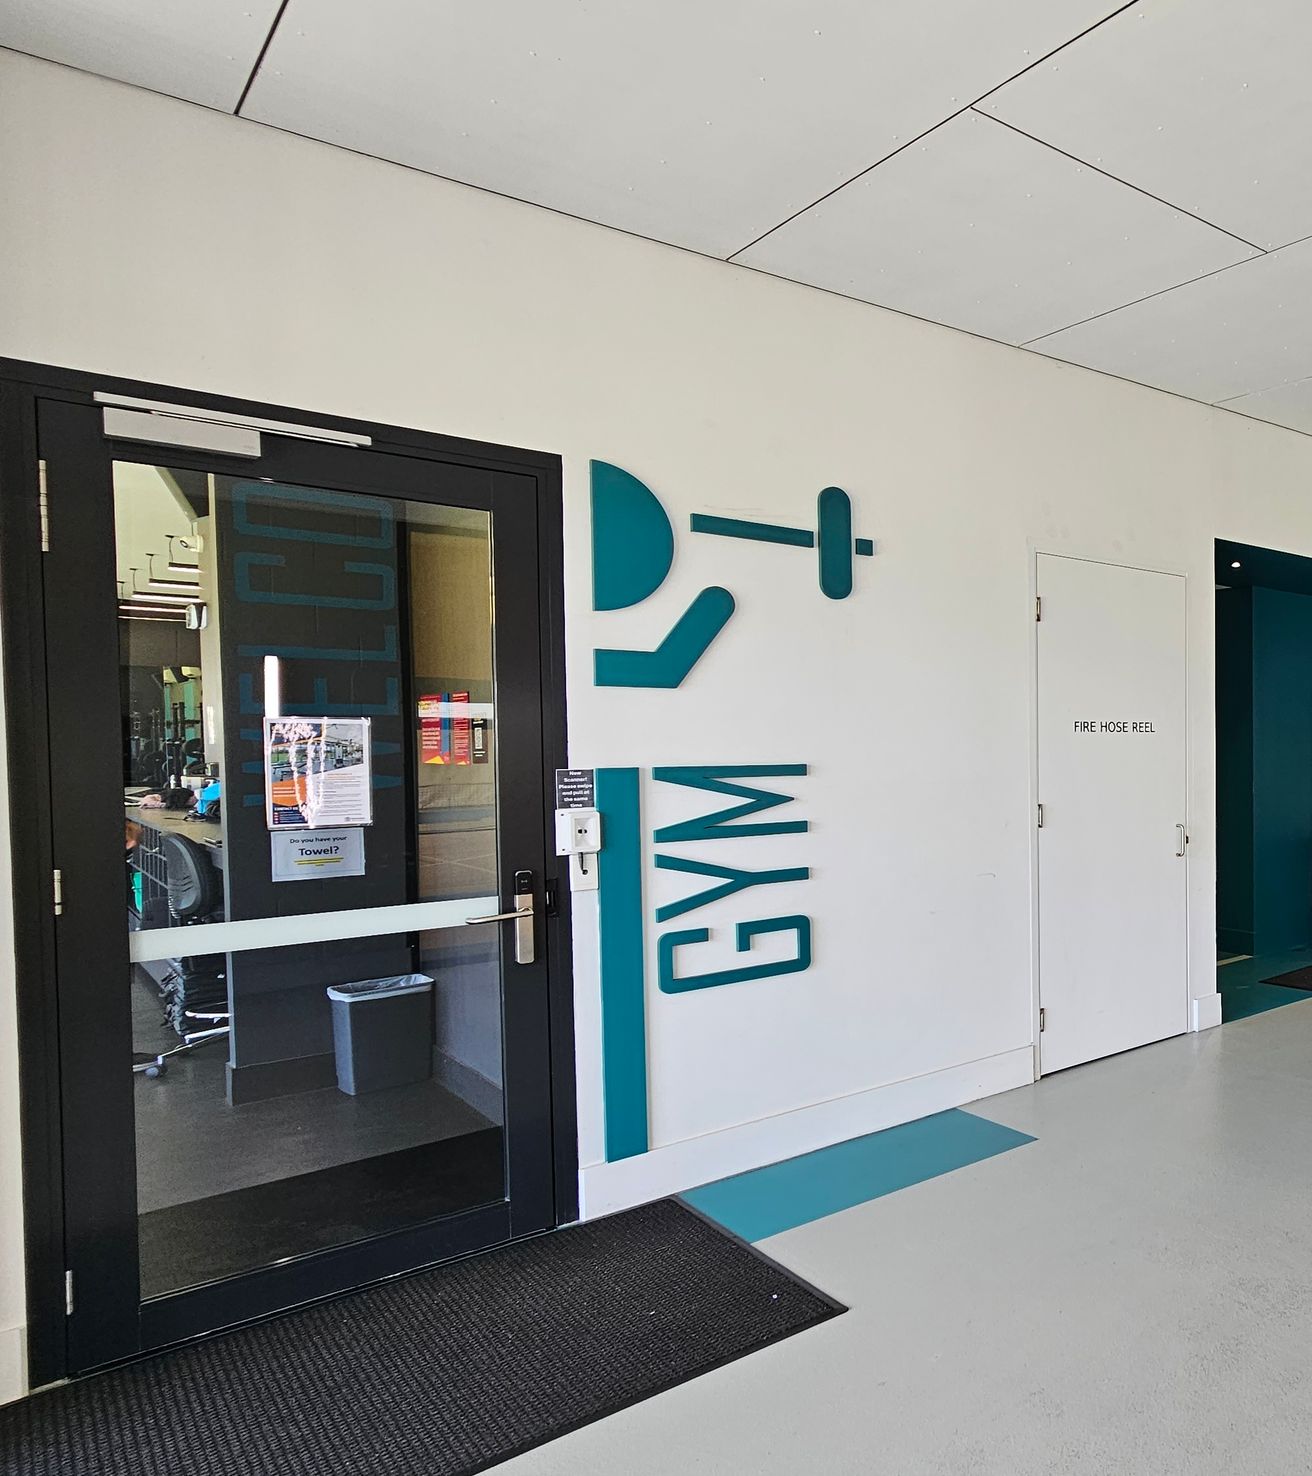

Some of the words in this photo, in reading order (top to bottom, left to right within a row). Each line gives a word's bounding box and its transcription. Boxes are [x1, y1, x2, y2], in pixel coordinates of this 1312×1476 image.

[1073, 721, 1097, 733] FIRE
[1099, 721, 1129, 733] HOSE
[1131, 721, 1156, 733] REEL
[298, 845, 341, 856] Towel?
[652, 763, 812, 995] GYM
